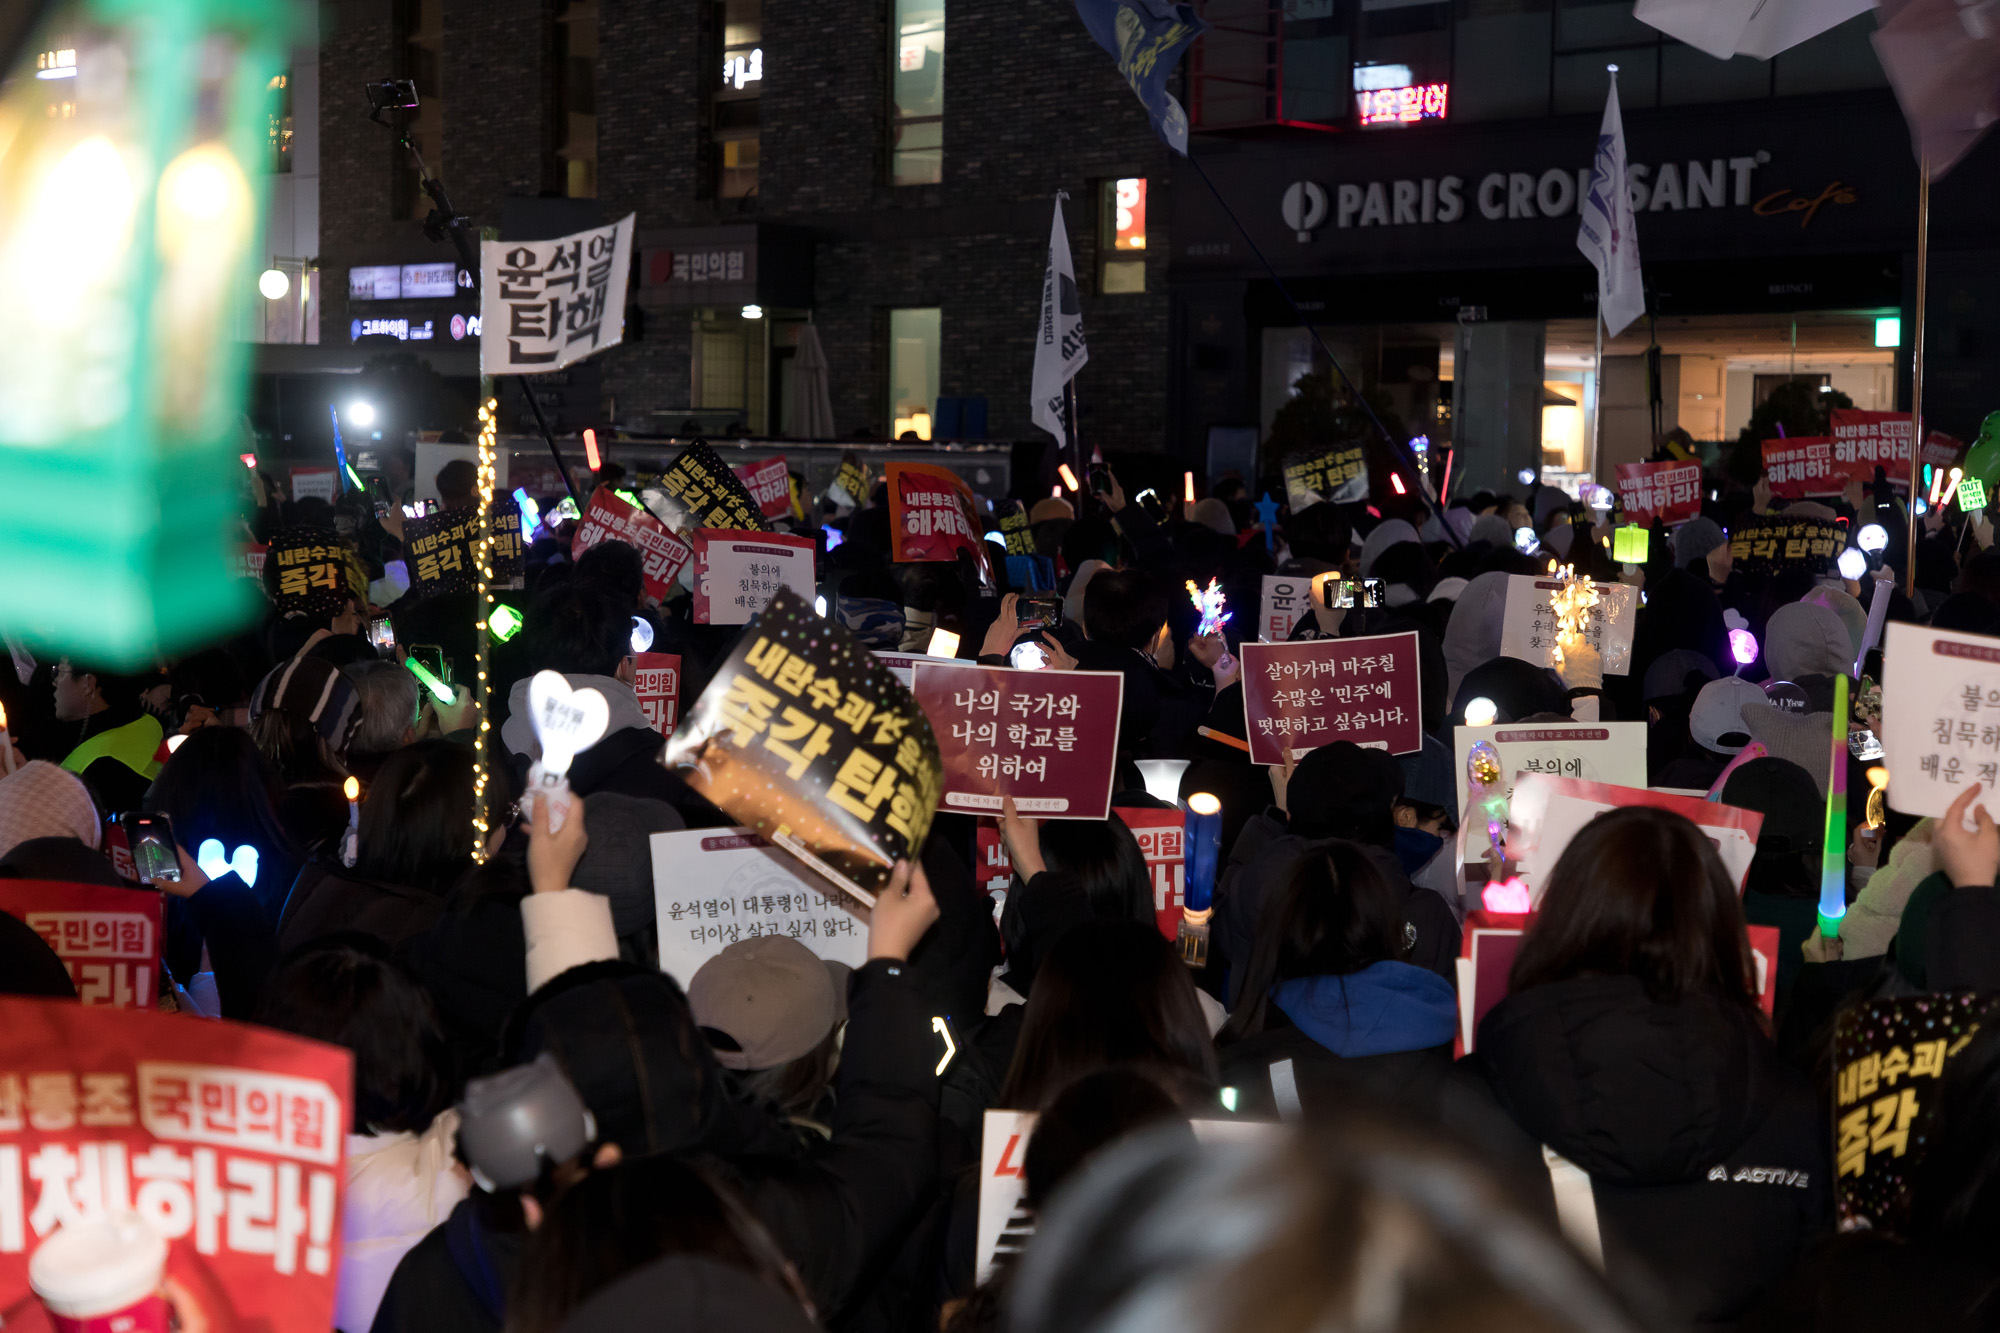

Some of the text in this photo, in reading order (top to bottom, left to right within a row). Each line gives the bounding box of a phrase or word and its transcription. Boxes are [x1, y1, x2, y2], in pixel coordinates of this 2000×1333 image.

[1337, 176, 1464, 229] PARIS
[1477, 157, 1756, 220] CROISANT
[497, 226, 618, 300] 윤석열
[672, 250, 745, 282] 국민의힘
[506, 283, 608, 365] 탄핵
[661, 467, 711, 515] 즉각
[680, 454, 730, 501] 내란수괴
[906, 491, 955, 507] 내란동조
[1622, 481, 1700, 513] 해체하라!
[590, 505, 638, 538] 내란동조
[411, 523, 466, 556] 내란수괴
[279, 562, 338, 596] 즉각
[416, 544, 463, 581] 즉각
[749, 562, 781, 578] 불의에
[734, 595, 758, 608] 배운
[1265, 653, 1396, 681] 살아가며 마주칠
[744, 636, 876, 735] 내란수괴
[1271, 680, 1392, 709] 수많은 '민주'에
[954, 688, 1082, 721] 나의 국가와
[1257, 706, 1409, 736] 떳떳하고 싶습니다.
[720, 673, 835, 782] 즉각
[952, 720, 1078, 752] 나의 학교를
[976, 753, 1047, 782] 위하여
[1919, 753, 1999, 790] 배운 적
[668, 891, 861, 921] 윤석열이 대통령인 나라에
[690, 923, 741, 945] 더이상
[786, 919, 817, 938] 싶지
[822, 917, 859, 937] 않다.
[1838, 1037, 1948, 1108] 내란수괴
[148, 1074, 326, 1154] 국민의힘
[1837, 1087, 1921, 1179] 즉각
[1707, 1164, 1810, 1189] A ACTIVE
